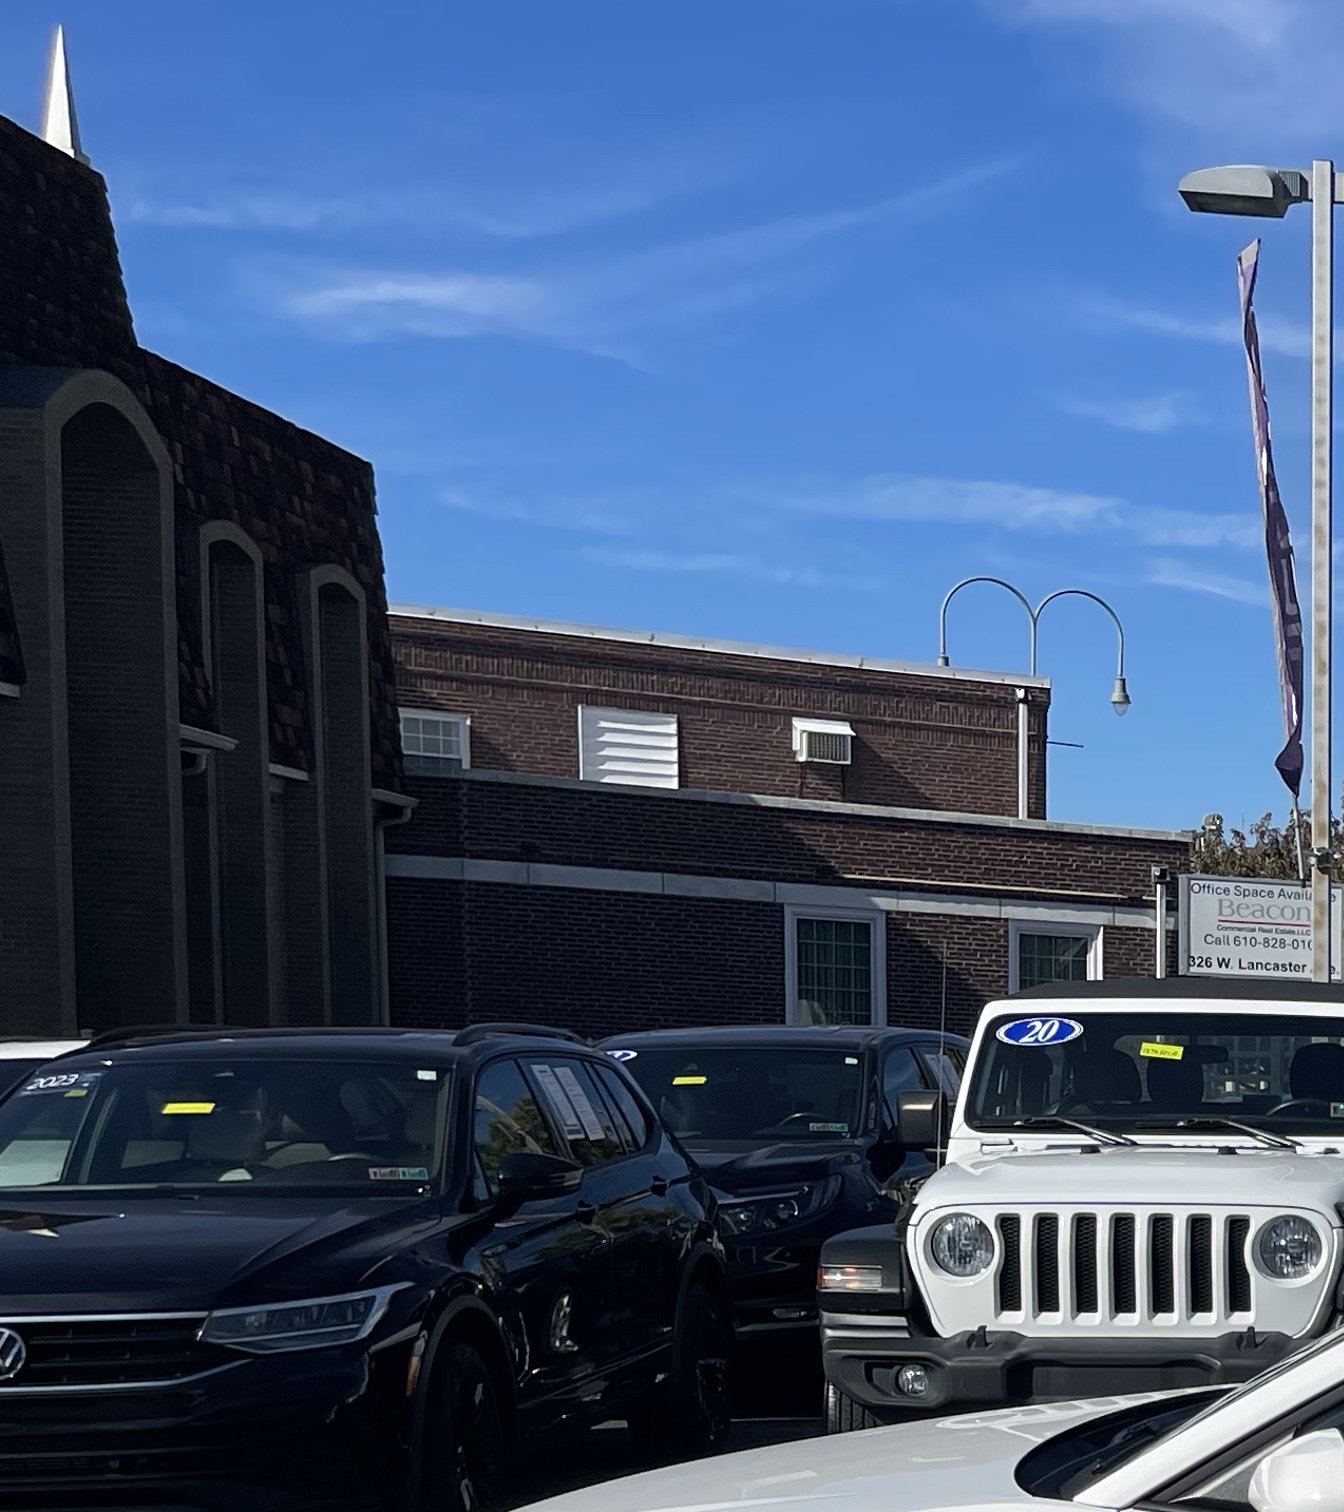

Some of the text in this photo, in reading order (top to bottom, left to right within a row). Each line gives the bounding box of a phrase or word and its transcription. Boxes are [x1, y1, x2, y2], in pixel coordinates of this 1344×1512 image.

[1190, 882, 1230, 896] Office
[1233, 885, 1274, 899] Space
[1217, 899, 1312, 921] Beacon
[1204, 934, 1231, 946] Call
[1189, 956, 1213, 968] 326
[1238, 958, 1307, 973] Lancaster
[1018, 1020, 1060, 1043] 20
[26, 1074, 79, 1090] 2023
